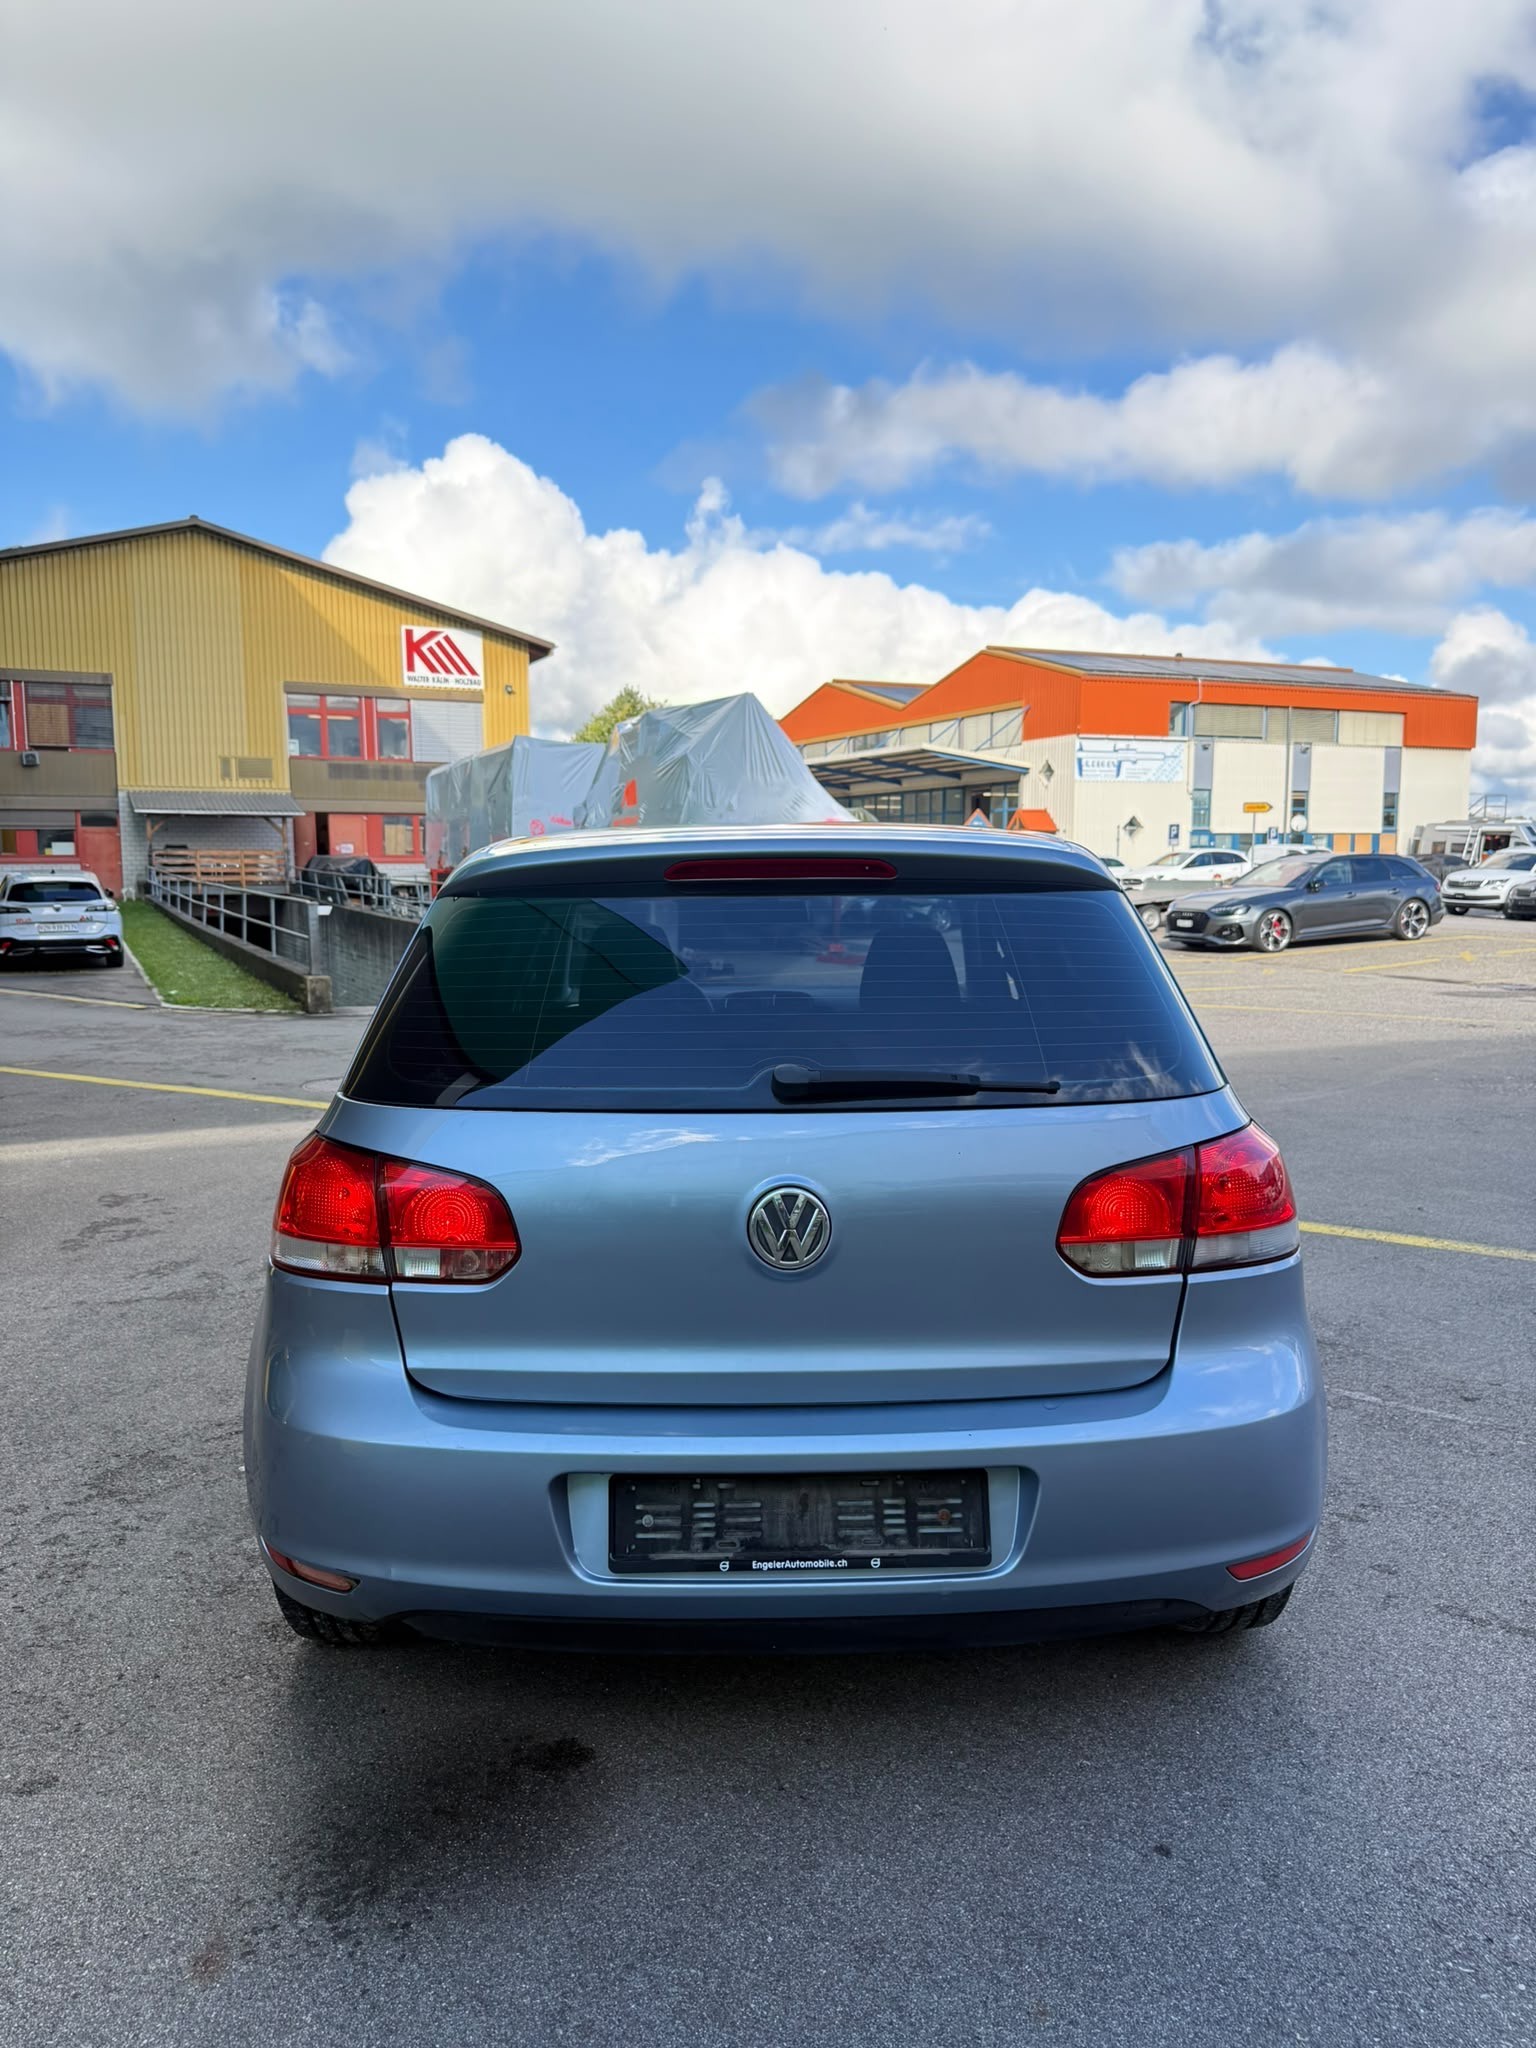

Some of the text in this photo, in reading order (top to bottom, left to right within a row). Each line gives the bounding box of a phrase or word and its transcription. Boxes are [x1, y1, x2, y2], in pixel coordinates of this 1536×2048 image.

[406, 675, 430, 683] WALTER
[454, 677, 482, 686] HOLZBAU
[1170, 826, 1177, 838] P
[752, 1559, 848, 1571] EngelerAutomobile.ch
